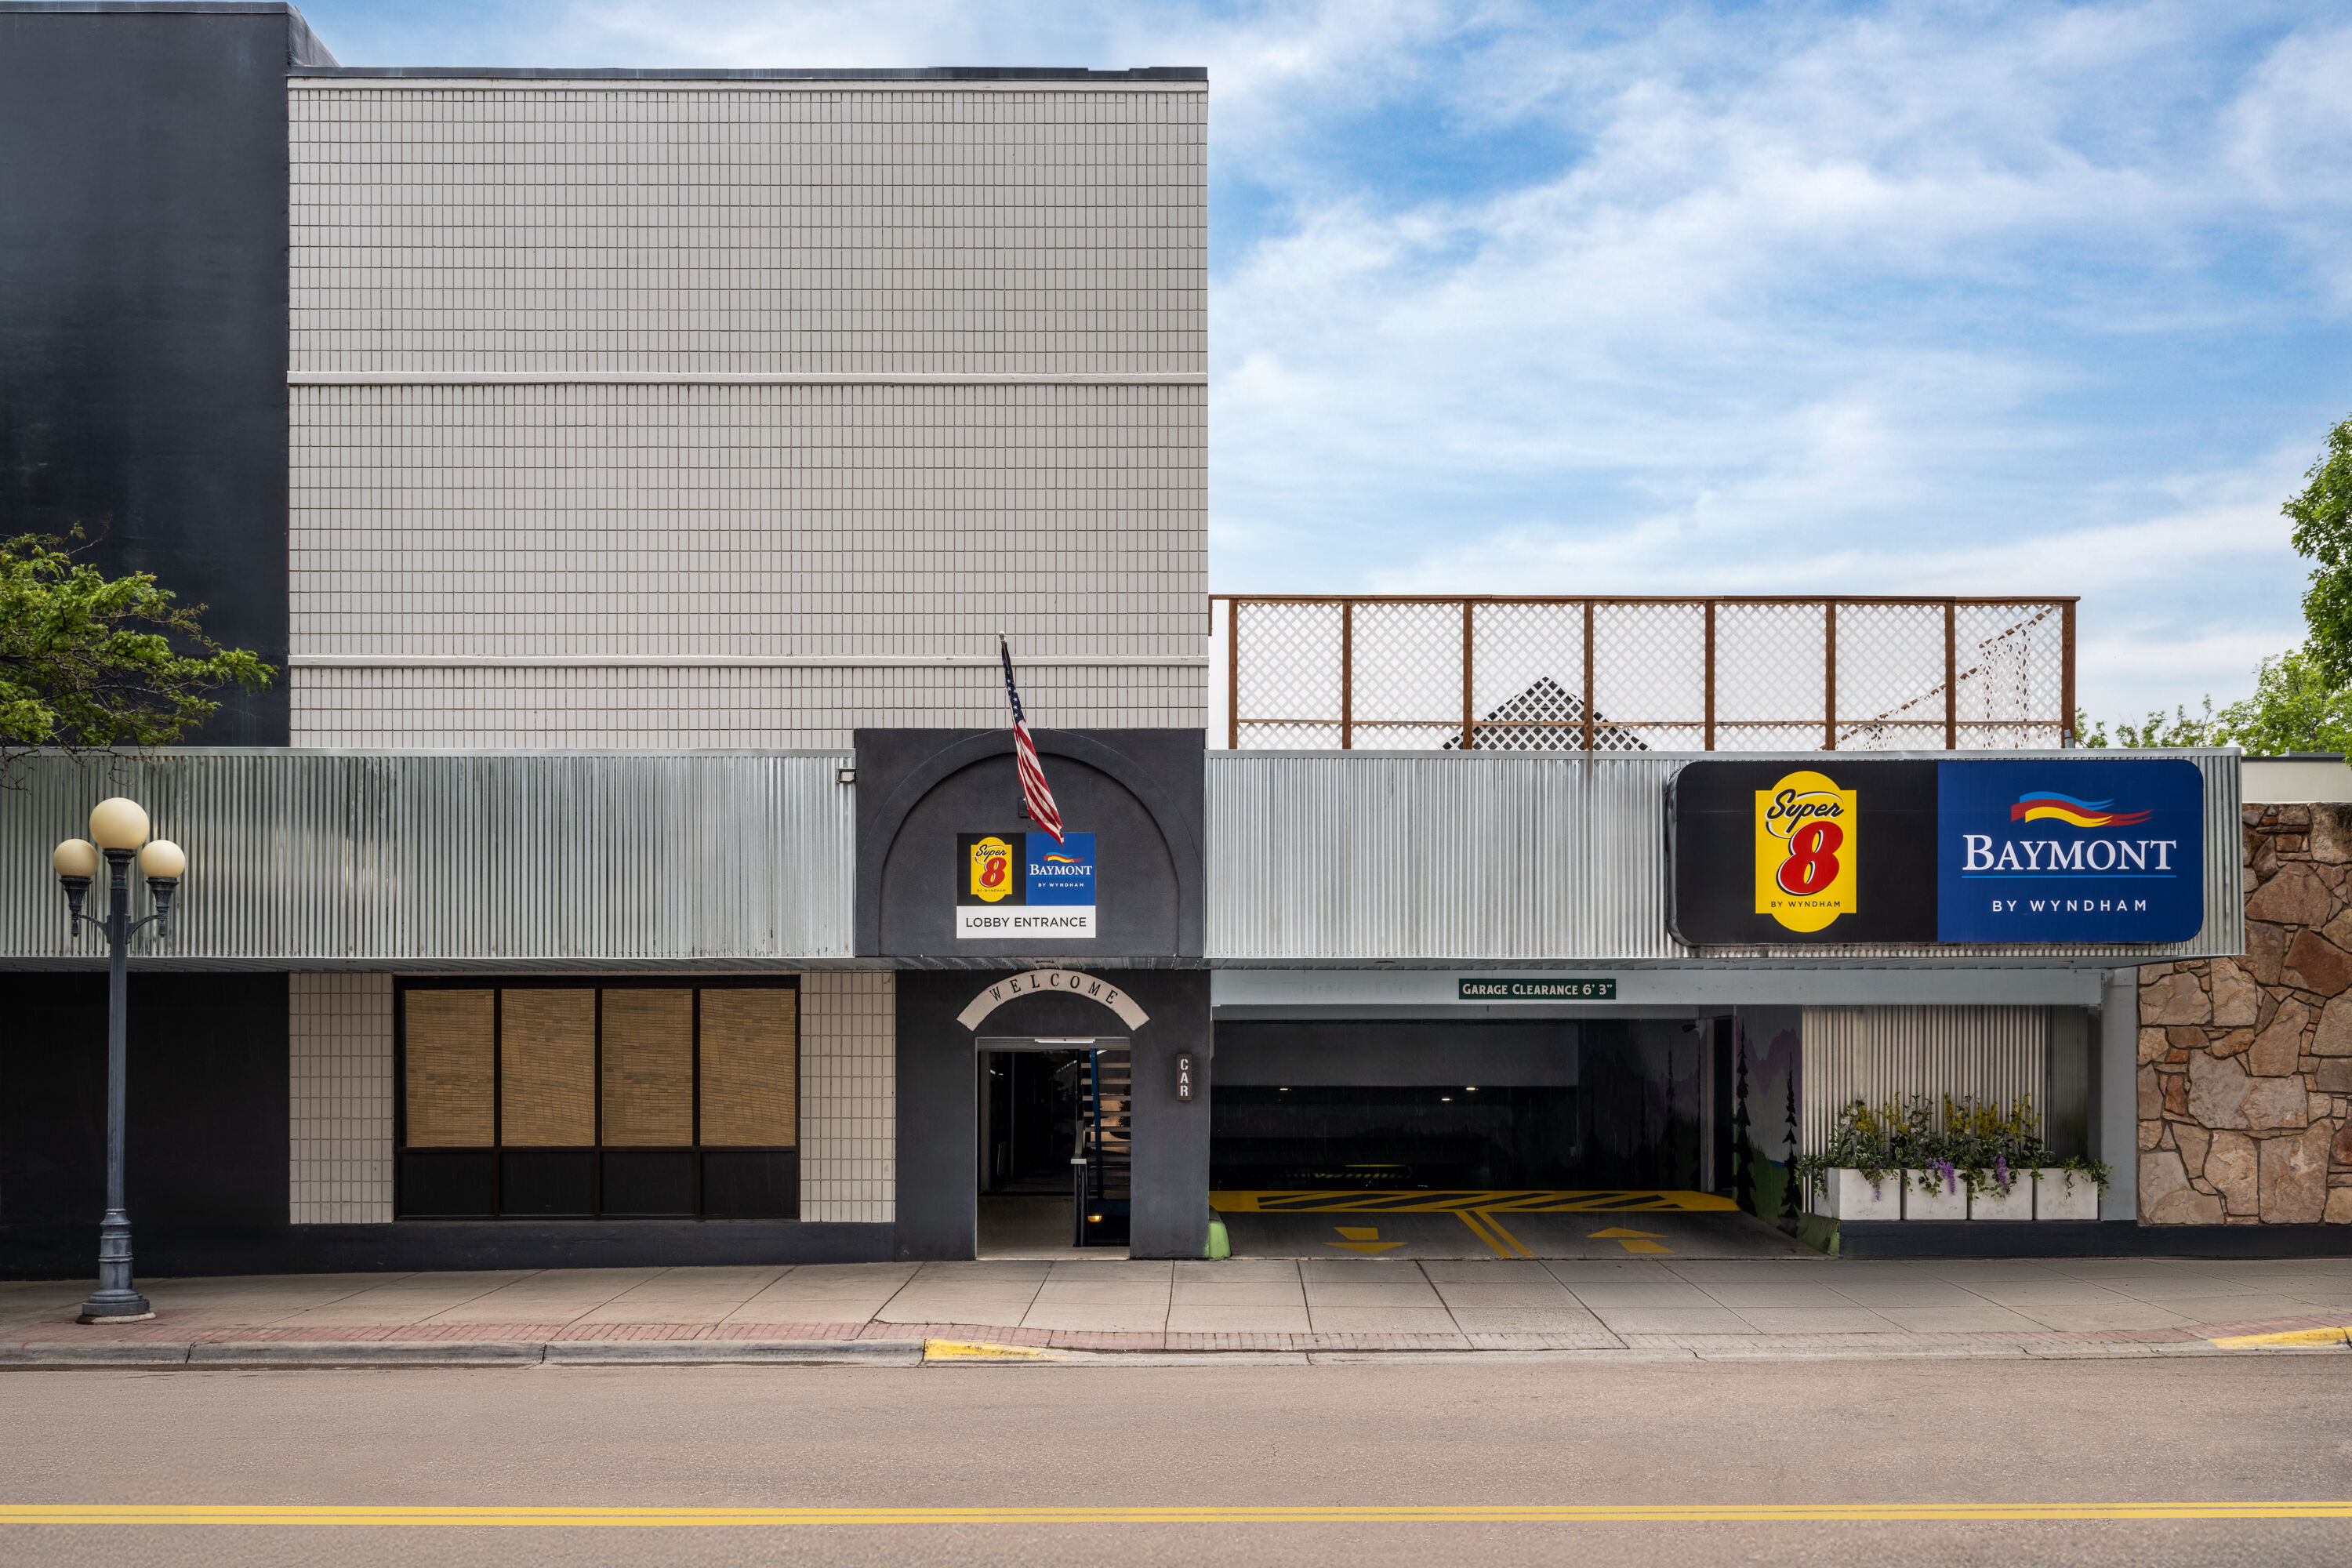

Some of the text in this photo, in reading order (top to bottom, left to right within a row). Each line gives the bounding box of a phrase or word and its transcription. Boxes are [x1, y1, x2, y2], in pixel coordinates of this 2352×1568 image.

[1765, 789, 1844, 833] Super
[975, 844, 1007, 862] Super
[1777, 821, 1843, 895] 8
[1962, 834, 2177, 871] BAYMONT
[979, 857, 1007, 887] 8
[1029, 864, 1092, 876] BAYMONT
[1993, 900, 2146, 912] BY WYNDHAM
[966, 917, 1087, 927] LOBBY ENTRANCE
[989, 974, 1118, 1004] WELCOME
[1462, 983, 1508, 995] GARAGE
[1512, 983, 1578, 995] CLEARANCE
[1180, 1058, 1189, 1097] CAR
